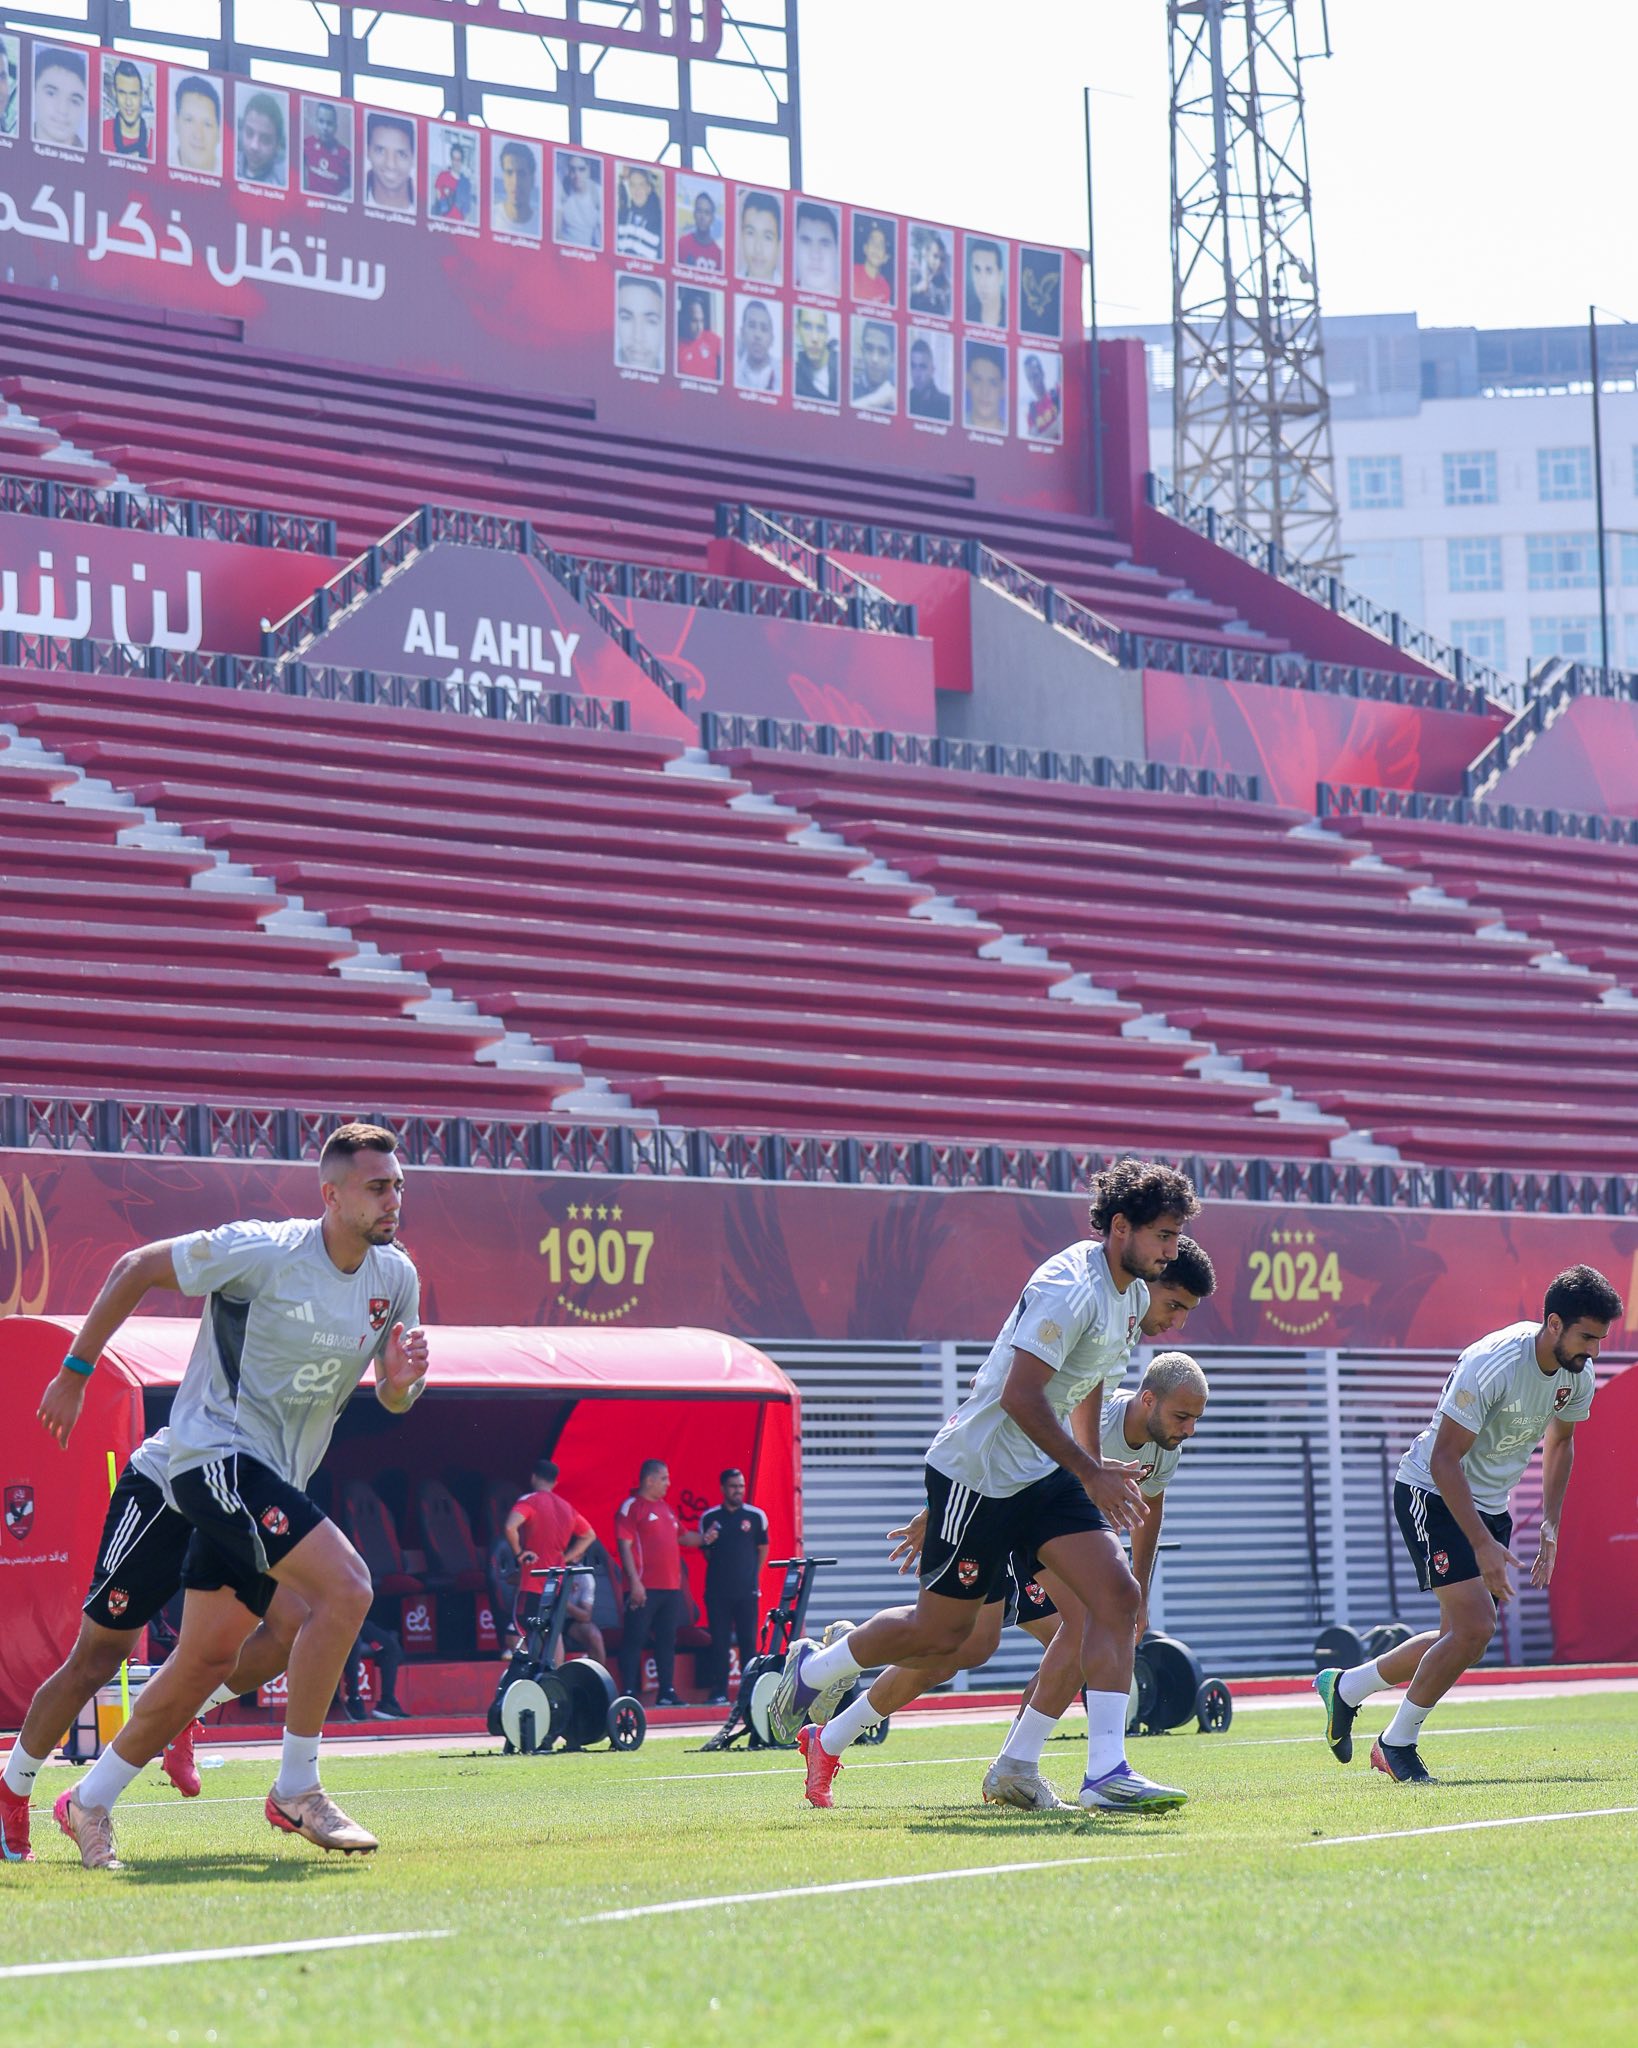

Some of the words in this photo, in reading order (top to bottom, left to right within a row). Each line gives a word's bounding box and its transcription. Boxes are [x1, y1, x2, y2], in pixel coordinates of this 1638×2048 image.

[206, 223, 386, 300] ستظل
[403, 607, 459, 659] AL
[470, 617, 580, 677] AHLY
[539, 1227, 654, 1285] 1907
[1248, 1250, 1343, 1302] 2024
